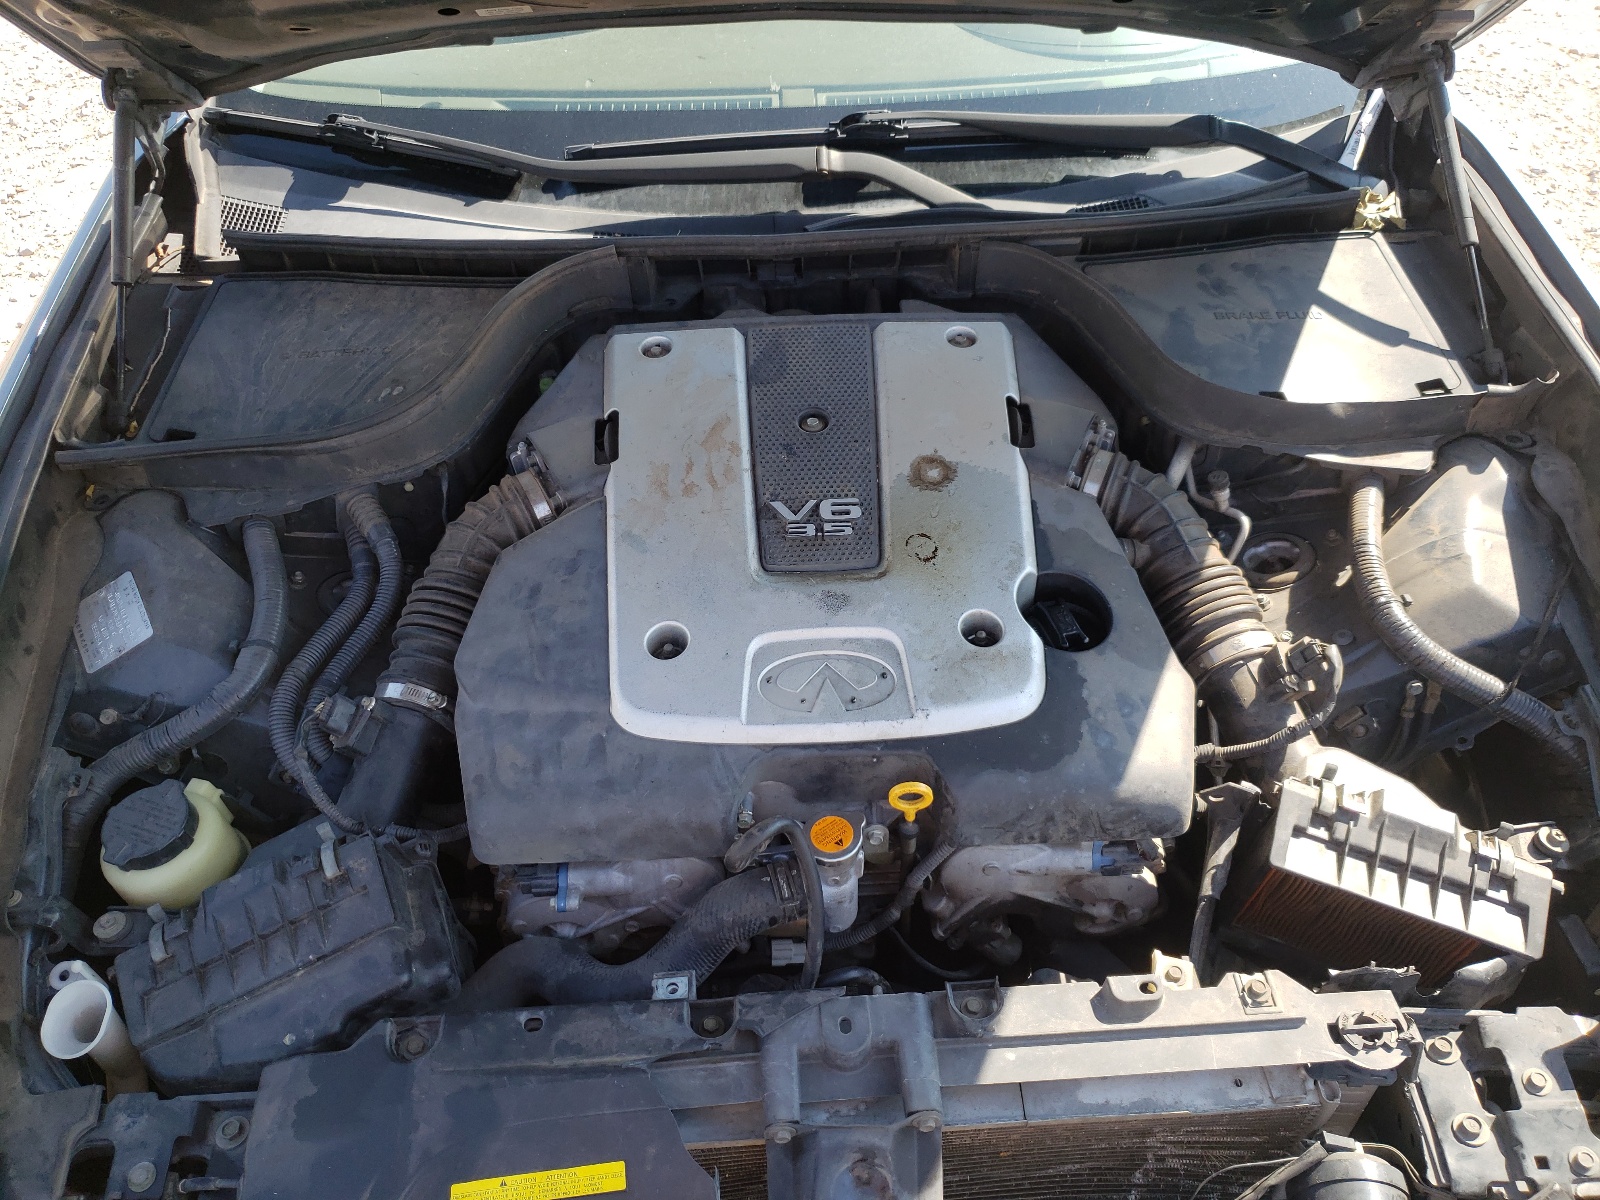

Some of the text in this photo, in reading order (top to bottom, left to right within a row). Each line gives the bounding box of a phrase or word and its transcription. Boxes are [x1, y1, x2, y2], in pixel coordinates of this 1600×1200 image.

[1213, 311, 1323, 320] BRAKE FLUID
[769, 498, 862, 520] V6
[786, 522, 853, 537] 3.5
[510, 1176, 537, 1185] CAUTION
[545, 1171, 578, 1181] ATTENTION
